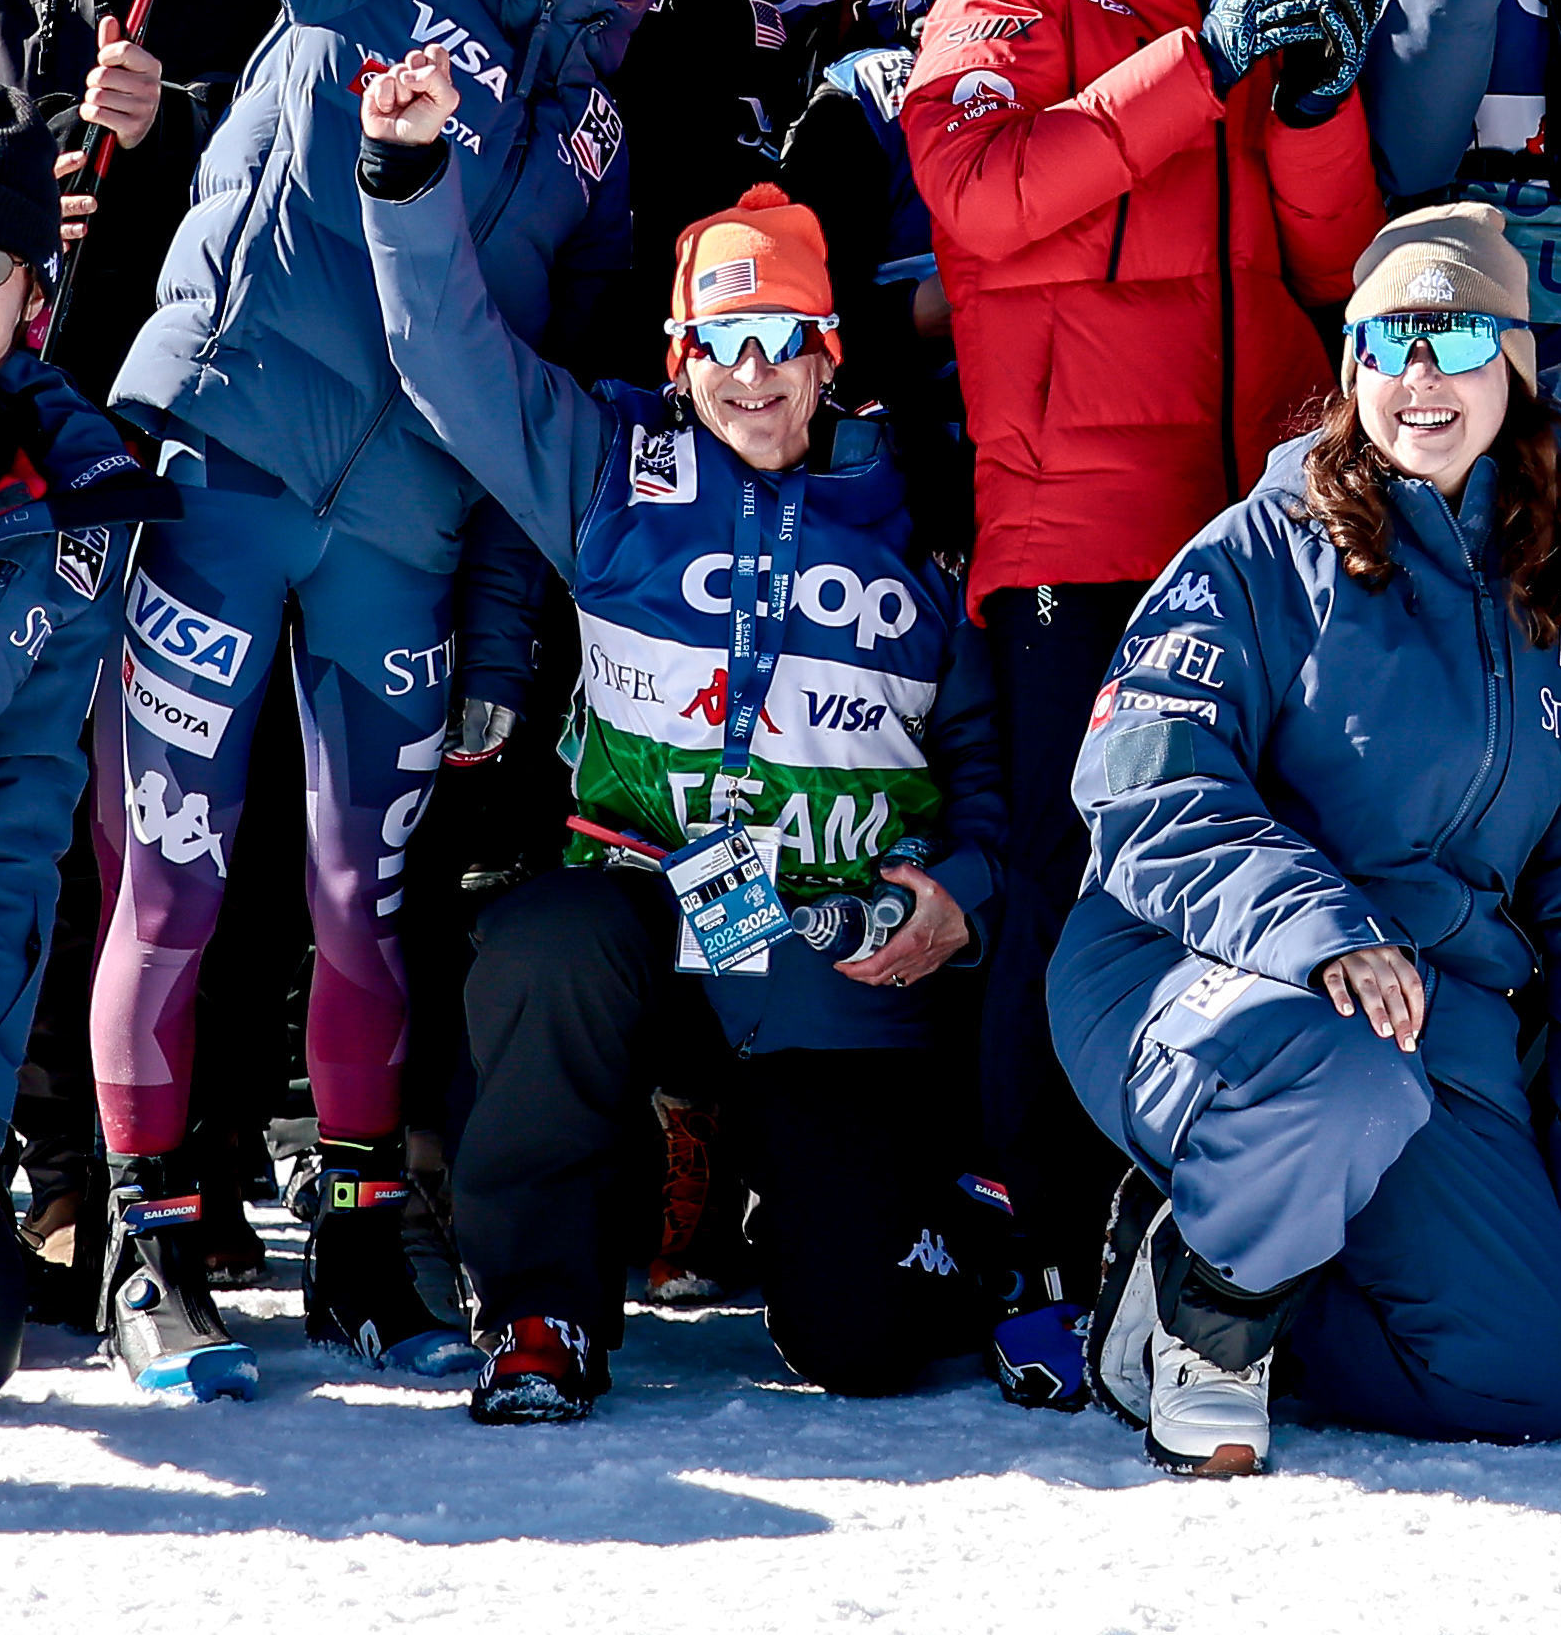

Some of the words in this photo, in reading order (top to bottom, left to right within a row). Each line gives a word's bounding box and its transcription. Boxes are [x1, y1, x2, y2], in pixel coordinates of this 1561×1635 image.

[639, 432, 677, 460] US
[137, 583, 230, 677] VISA
[590, 643, 665, 706] STIFEL
[1114, 635, 1225, 689] STIFEL
[133, 683, 210, 738] TOYOTA
[800, 686, 888, 732] VISA
[1121, 691, 1217, 726] TOYOTA
[691, 892, 700, 904] 2
[727, 875, 735, 886] 6
[738, 902, 781, 933] 2024
[143, 1202, 198, 1222] SALOMON
